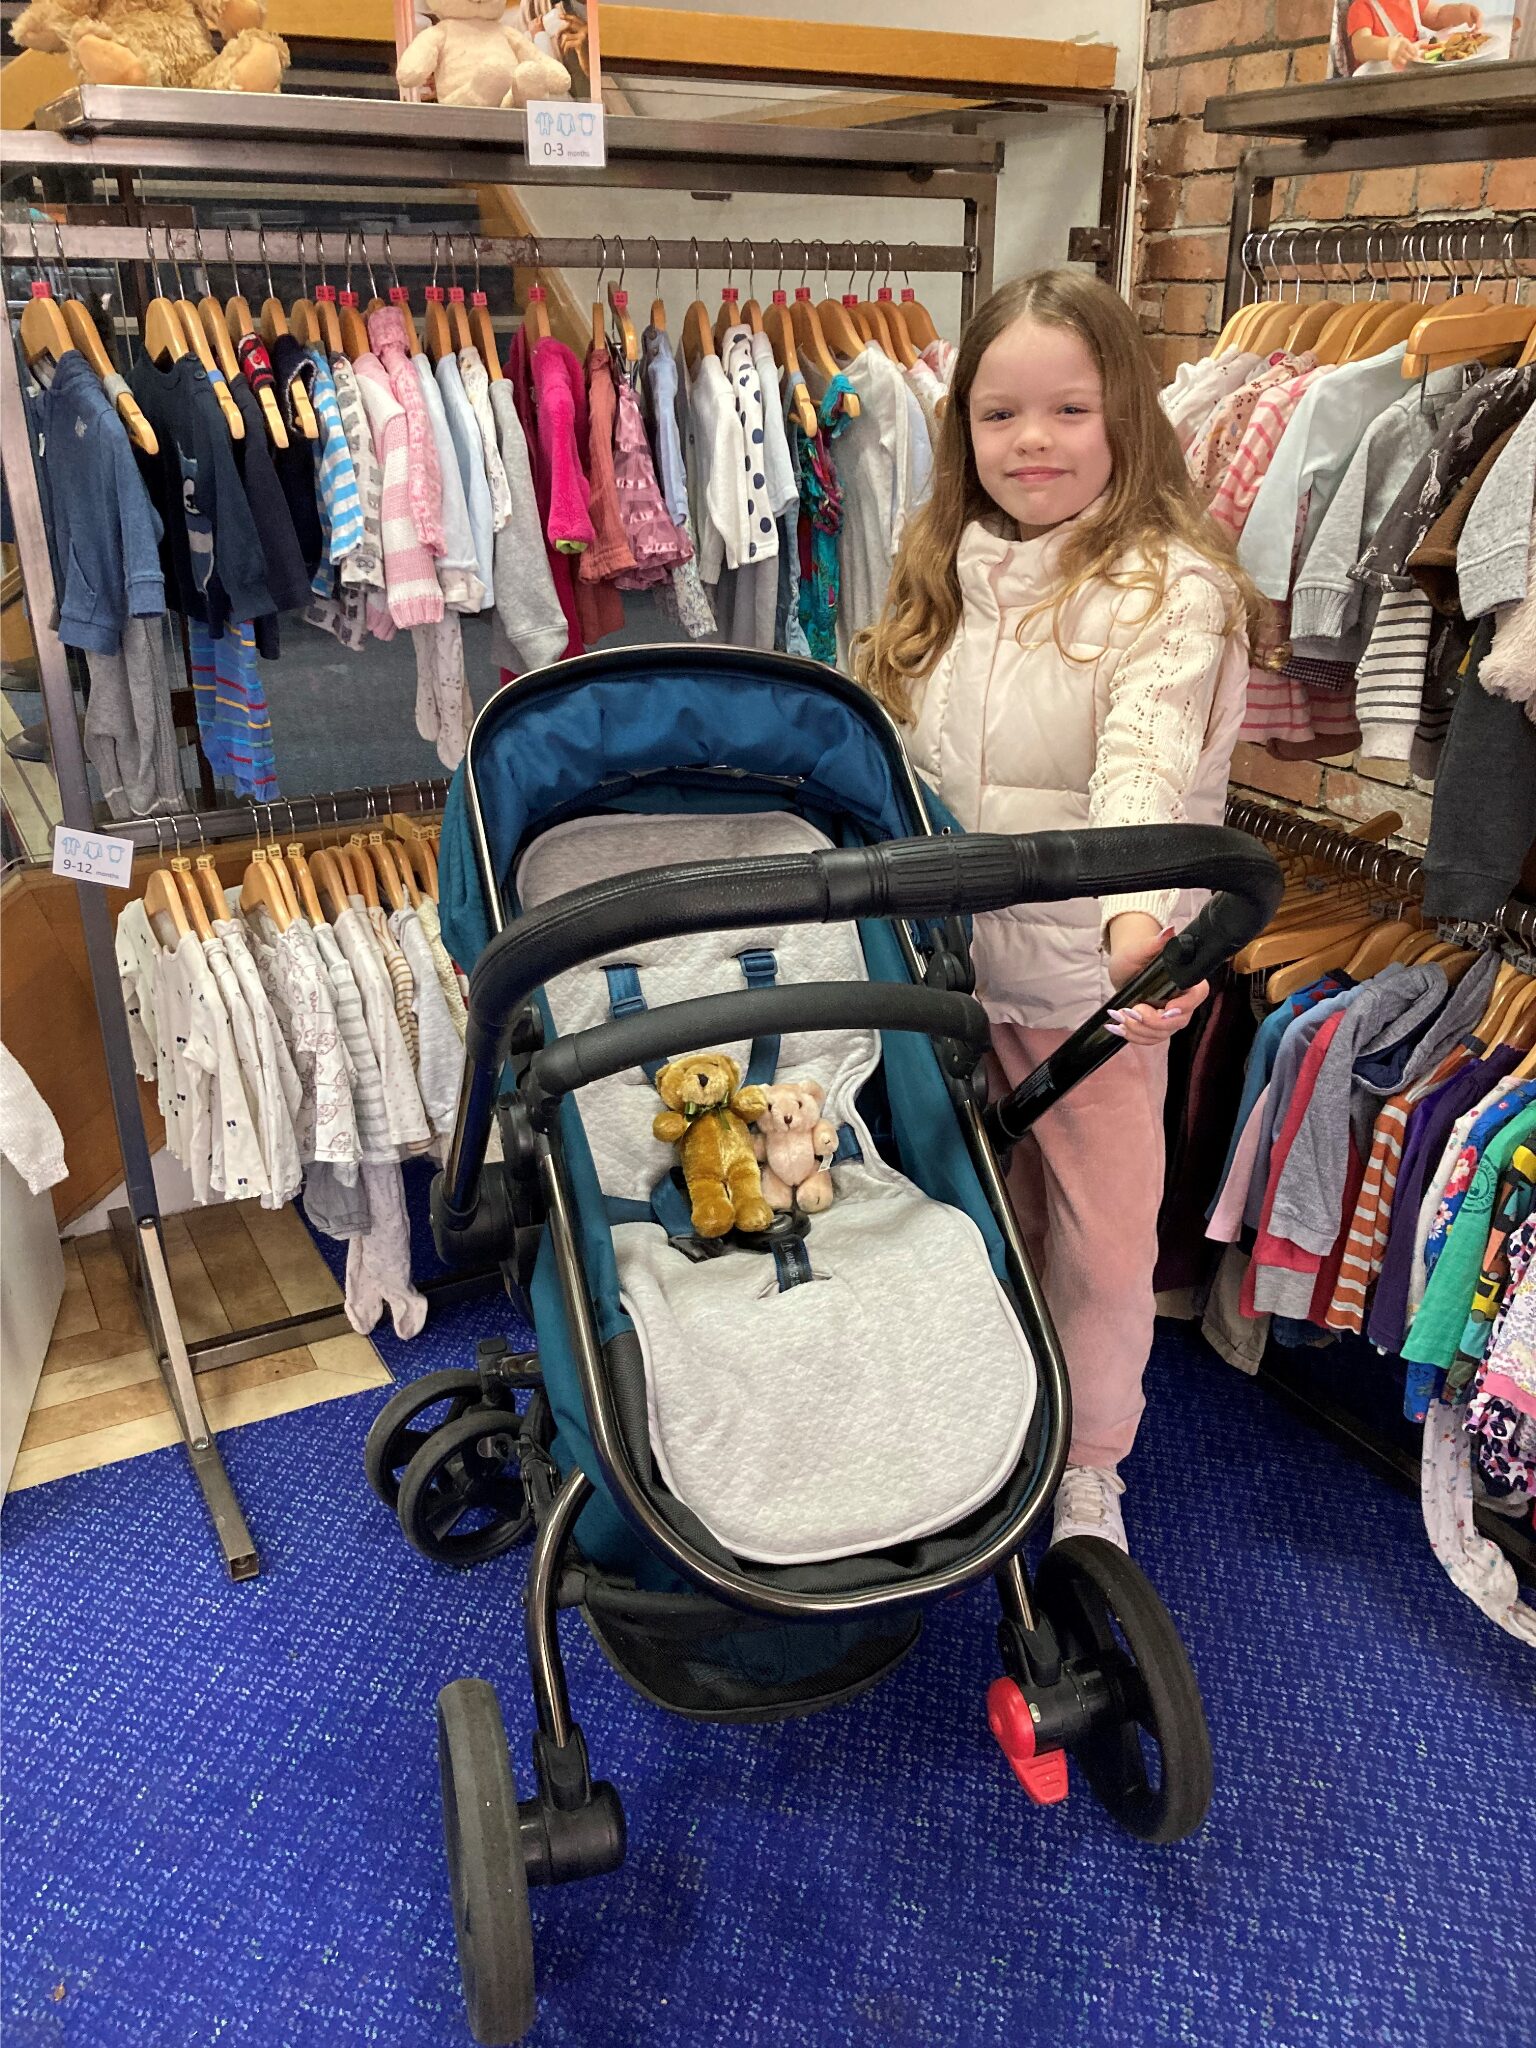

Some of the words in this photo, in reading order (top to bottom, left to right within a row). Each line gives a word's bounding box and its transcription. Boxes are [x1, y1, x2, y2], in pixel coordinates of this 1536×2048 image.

[543, 142, 564, 156] 0-3
[567, 149, 590, 157] months
[63, 859, 92, 874] 9-12
[95, 870, 119, 879] months
